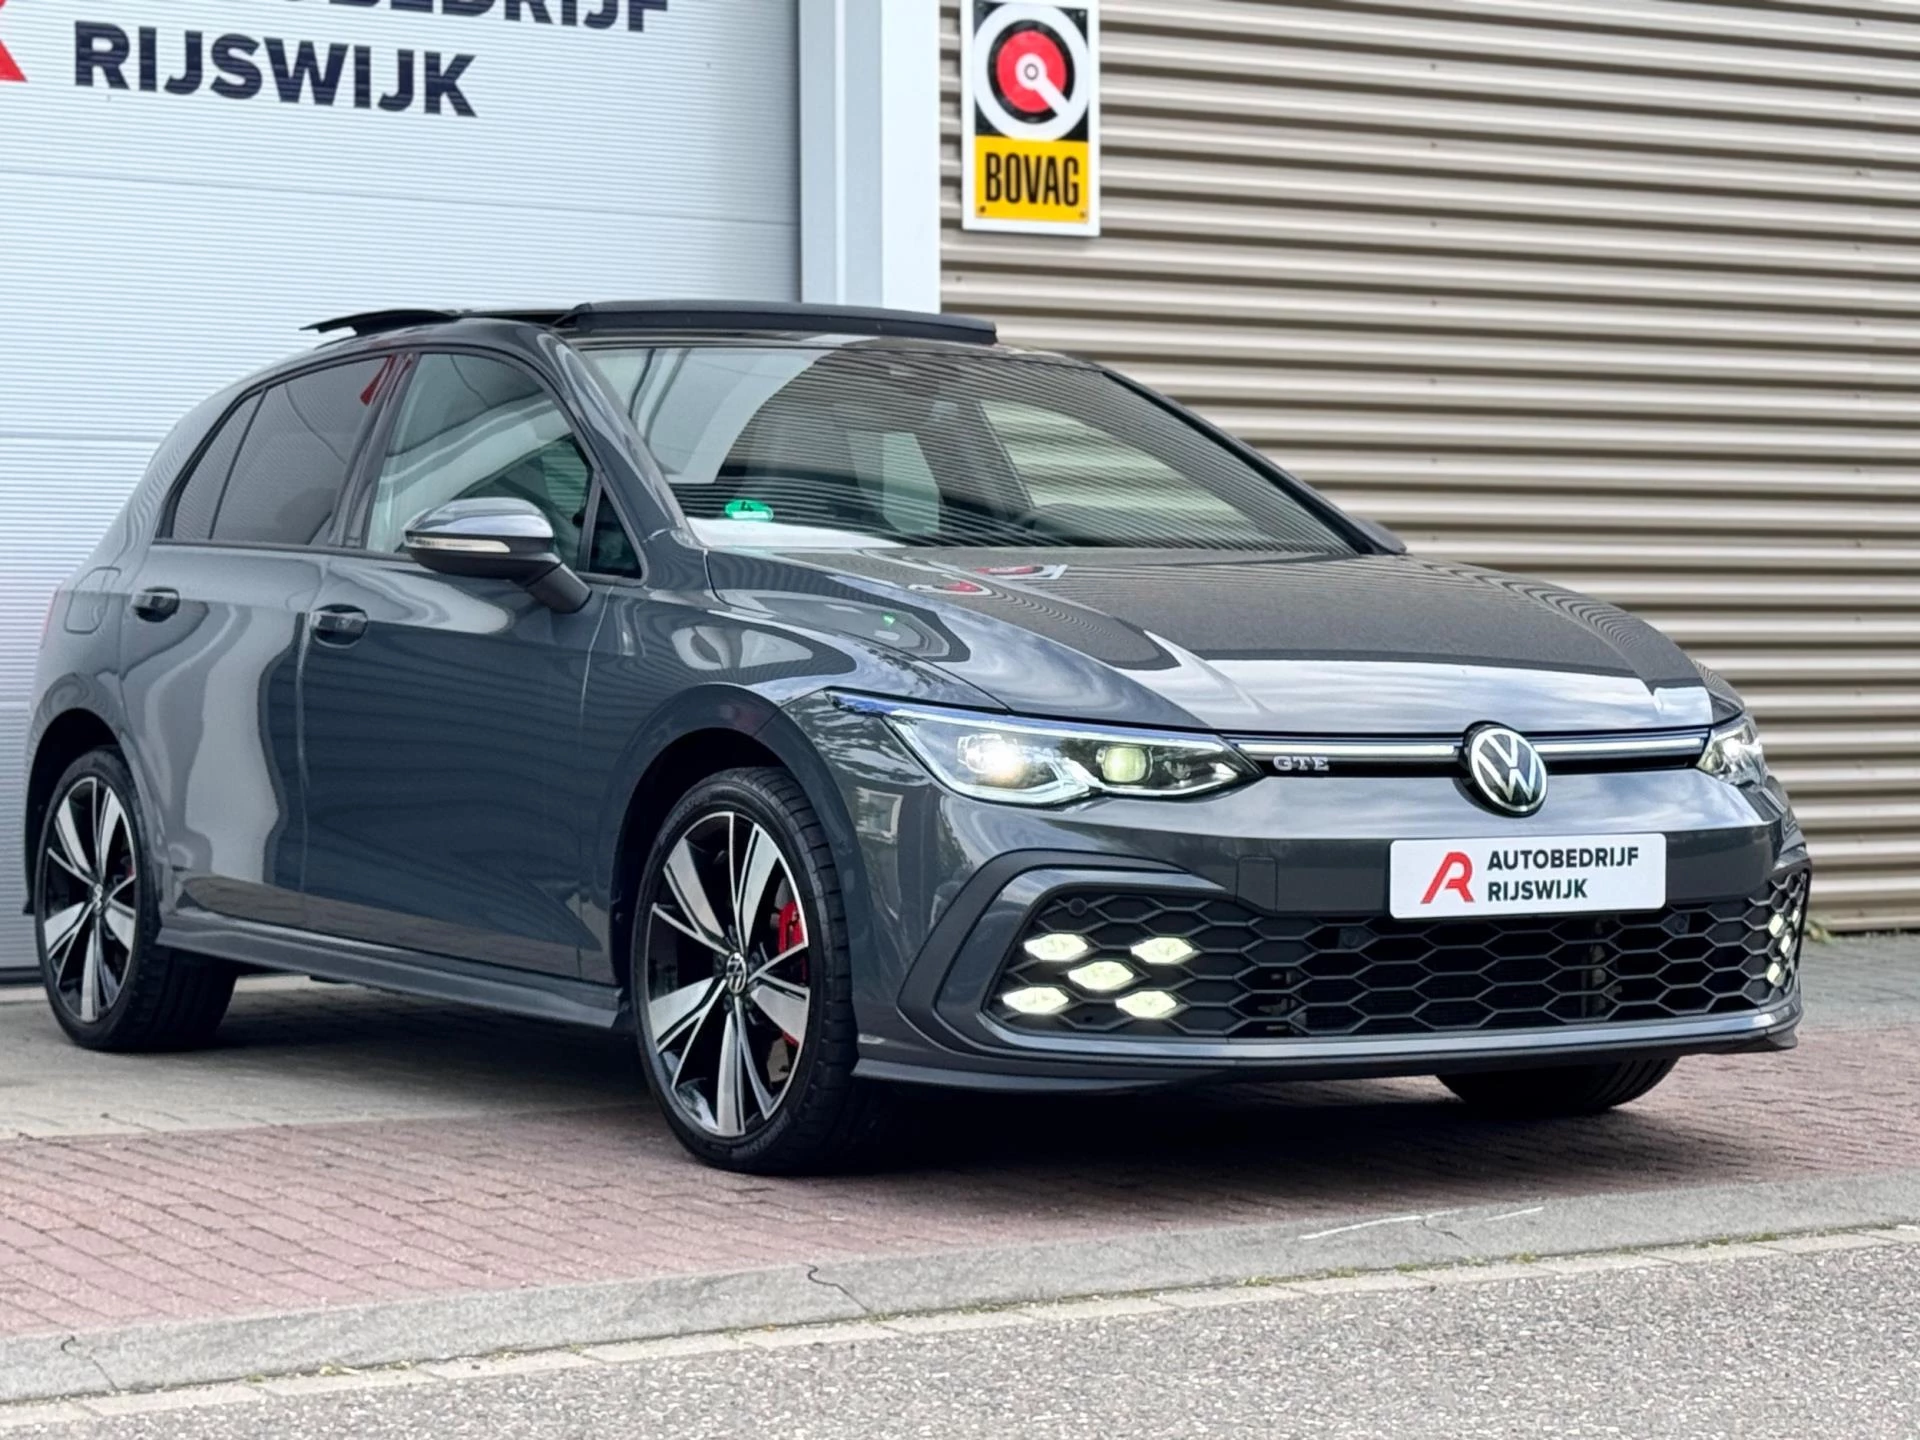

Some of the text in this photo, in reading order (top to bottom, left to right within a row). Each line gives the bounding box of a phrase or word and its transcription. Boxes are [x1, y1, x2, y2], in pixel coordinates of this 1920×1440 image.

[75, 20, 478, 118] RIJSWIJK
[985, 151, 1079, 207] BOVAG
[1273, 755, 1330, 771] GTE
[1487, 847, 1639, 871] AUTOBEDRIJF
[1487, 878, 1588, 902] RIJSWIJK
